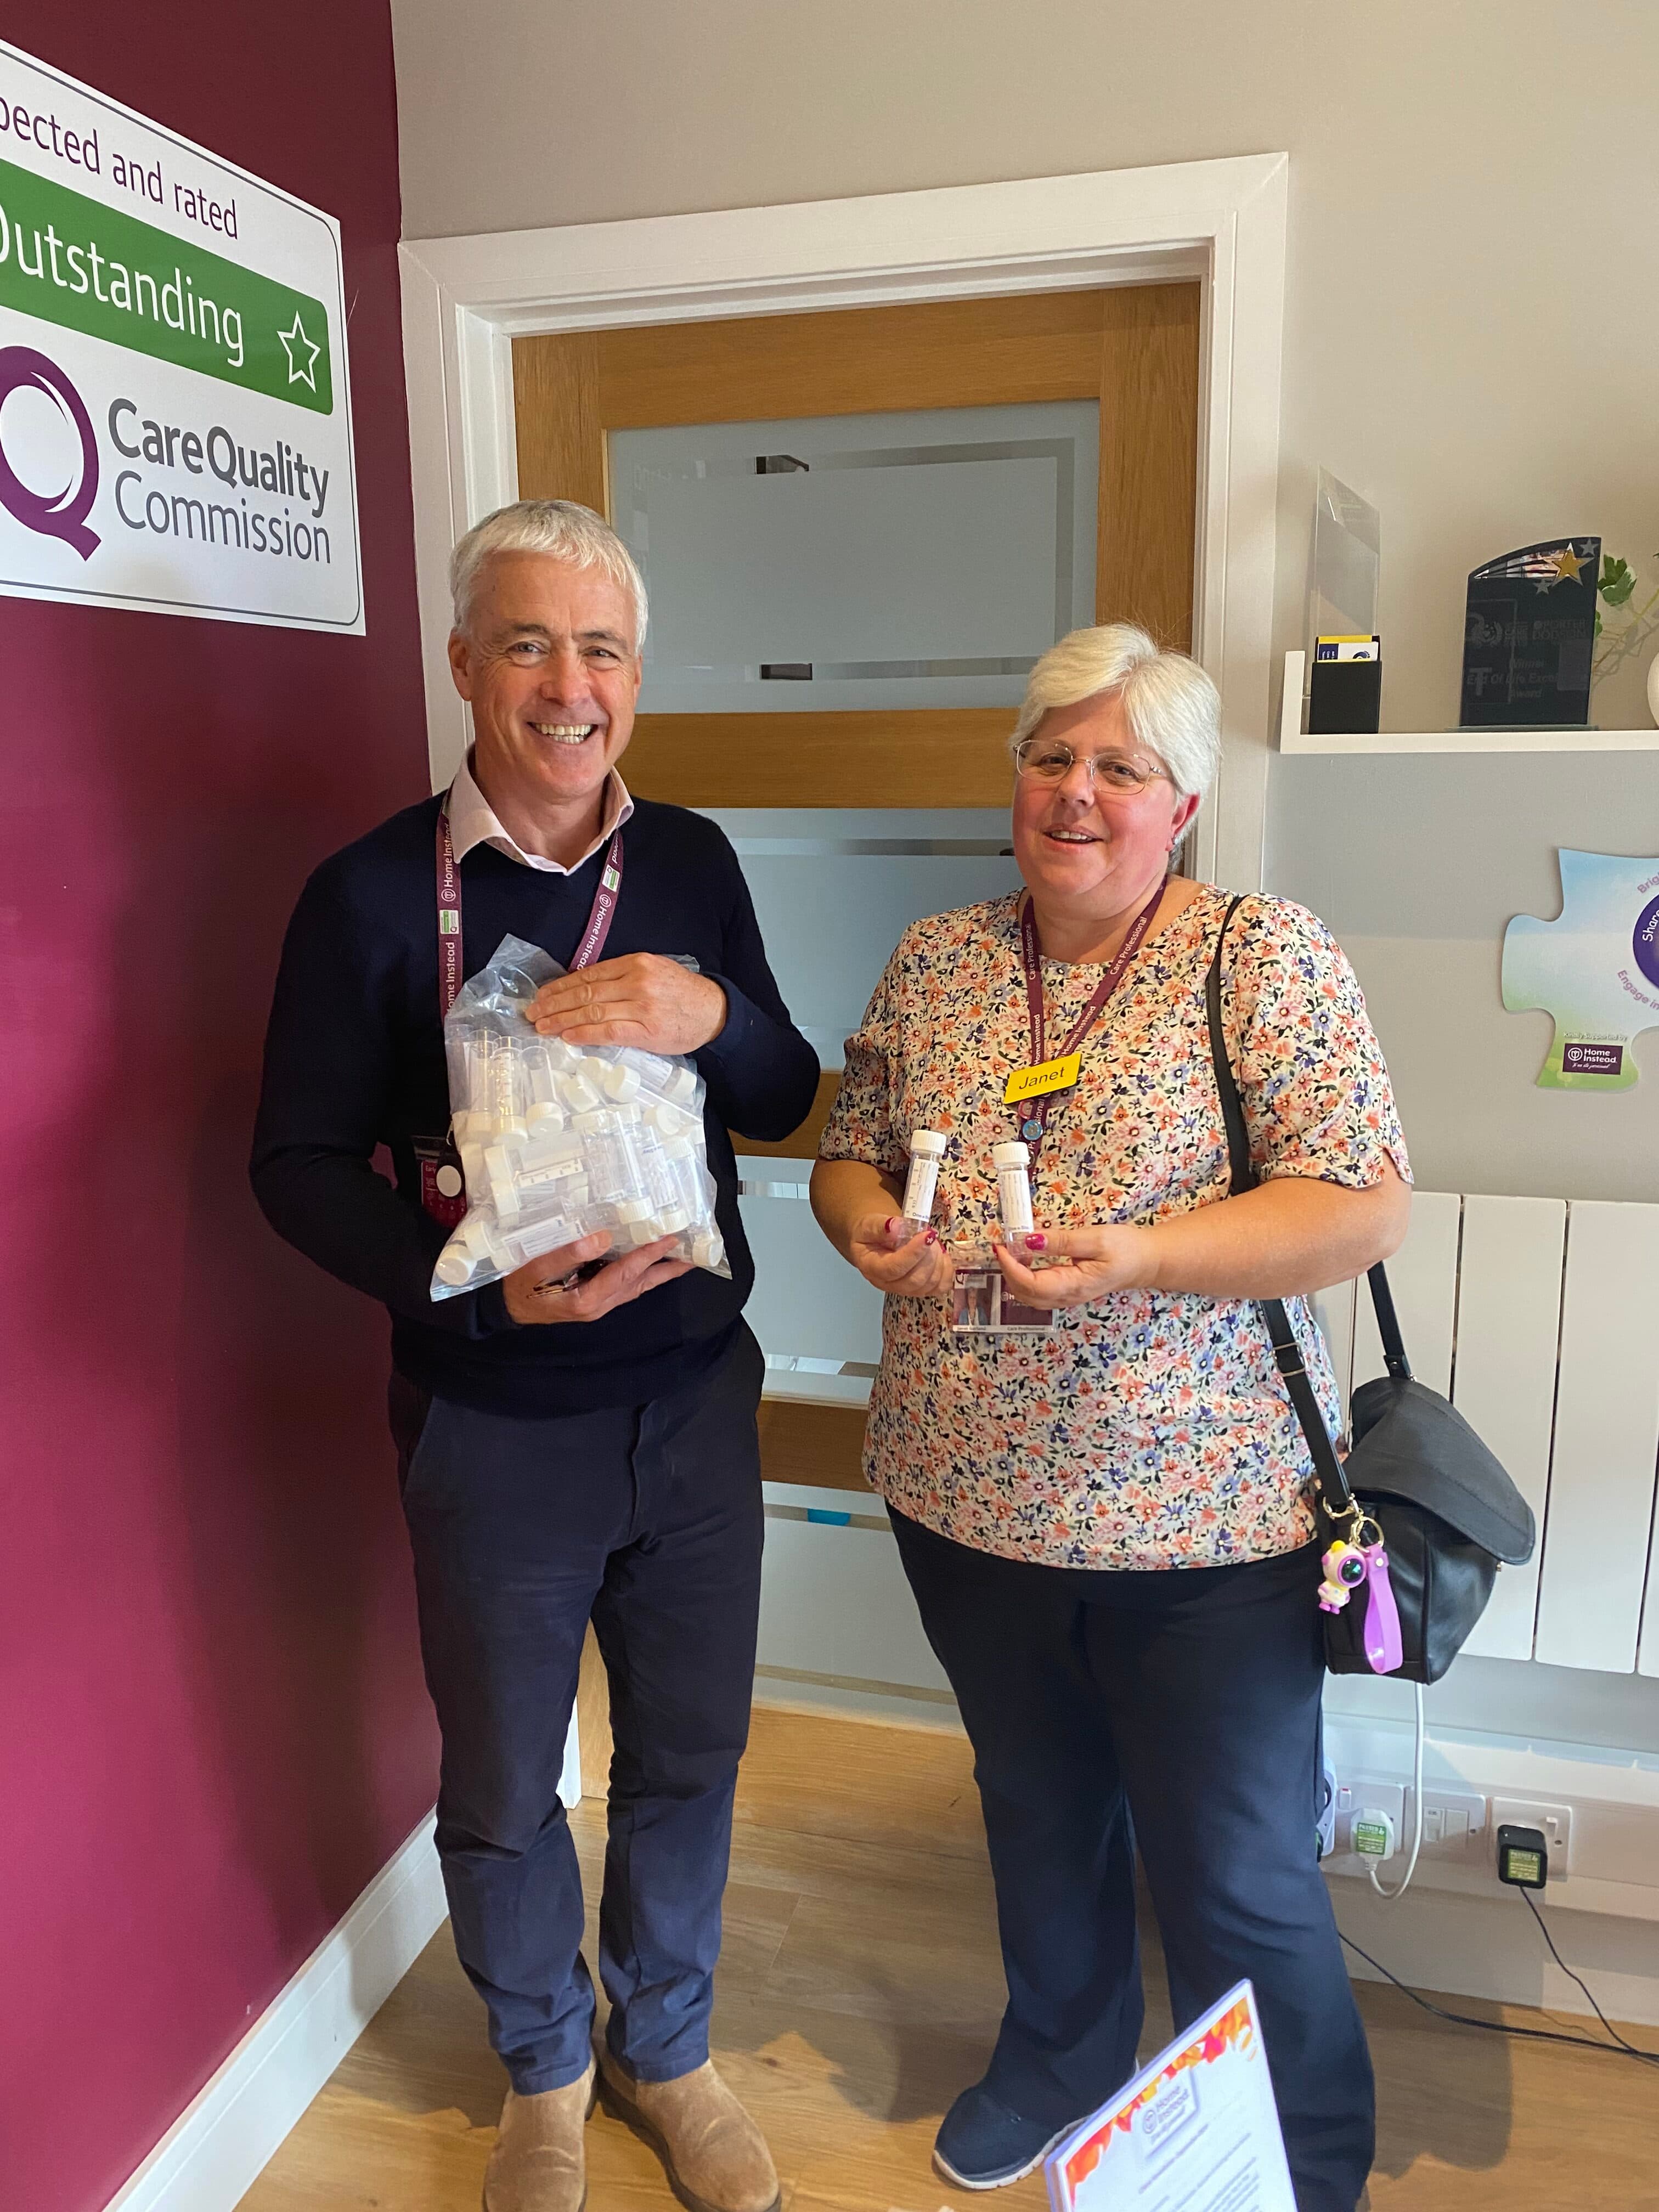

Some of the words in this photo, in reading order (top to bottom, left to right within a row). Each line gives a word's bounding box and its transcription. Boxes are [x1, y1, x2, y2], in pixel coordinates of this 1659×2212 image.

[112, 153, 163, 204] and
[174, 183, 238, 240] rated
[115, 470, 330, 563] Commission
[443, 857, 453, 888] Home
[1637, 872, 1659, 893] Brig
[592, 906, 607, 935] Home
[1025, 924, 1035, 962] Professiona
[1109, 957, 1123, 975] Care
[1121, 916, 1148, 959] Professional
[445, 942, 455, 982] Instead
[1617, 970, 1649, 1003] Engage
[1062, 1032, 1076, 1057] Home
[1075, 1006, 1096, 1034] Instead
[1583, 1055, 1616, 1063] Instead
[1584, 1048, 1611, 1056] Home
[1019, 1066, 1065, 1090] Janet
